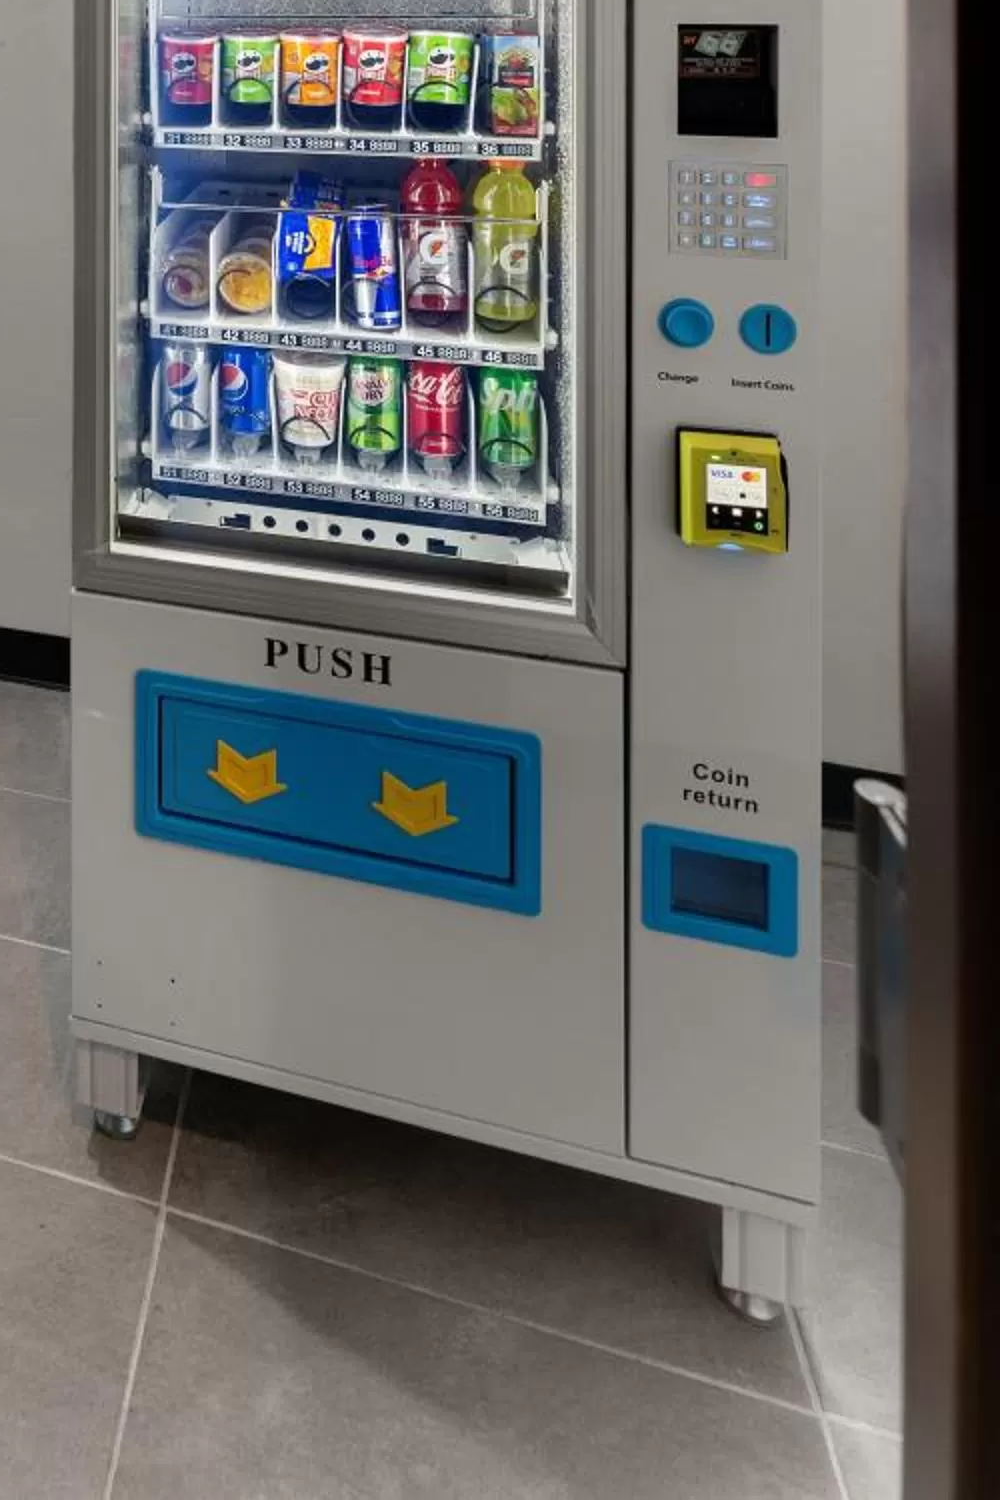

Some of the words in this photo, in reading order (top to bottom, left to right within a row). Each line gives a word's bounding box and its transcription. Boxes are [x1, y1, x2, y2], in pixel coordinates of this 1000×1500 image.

[225, 136, 241, 146] 32
[350, 140, 366, 150] 34
[413, 141, 430, 153] 35
[223, 329, 239, 340] 42
[281, 334, 297, 346] 43
[345, 341, 362, 351] 44
[656, 371, 699, 385] Change
[731, 377, 762, 390] Insert
[764, 380, 796, 392] Coins
[263, 637, 392, 687] PUSH
[692, 762, 750, 788] Coin
[682, 788, 759, 815] return
